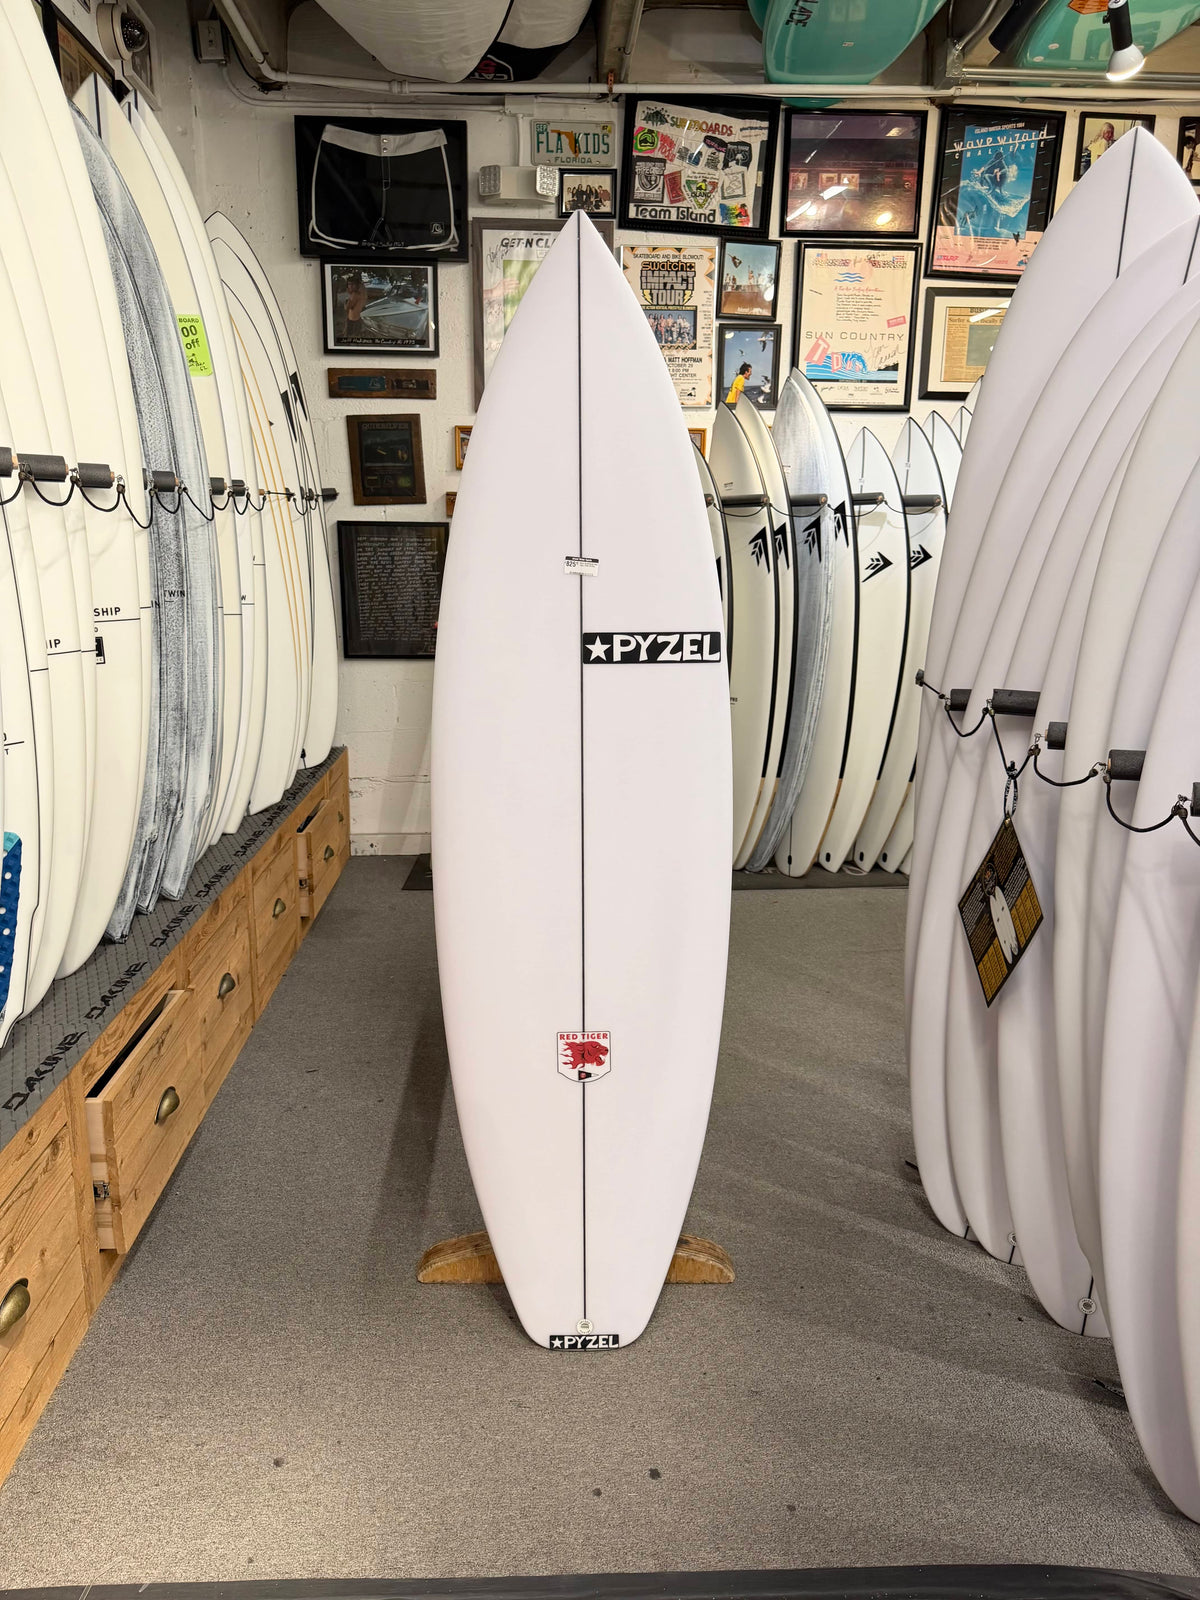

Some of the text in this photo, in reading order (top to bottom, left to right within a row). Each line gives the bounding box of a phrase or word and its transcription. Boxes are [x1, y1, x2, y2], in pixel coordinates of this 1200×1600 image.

[536, 131, 610, 154] FLA KIDS
[634, 204, 716, 223] Team Island
[640, 270, 696, 291] IMPACT
[652, 289, 684, 305] TOUR
[185, 338, 200, 350] off
[805, 331, 905, 341] SUN COUNTRY
[613, 634, 721, 662] PYZEL
[564, 1335, 619, 1349] PYZEL
